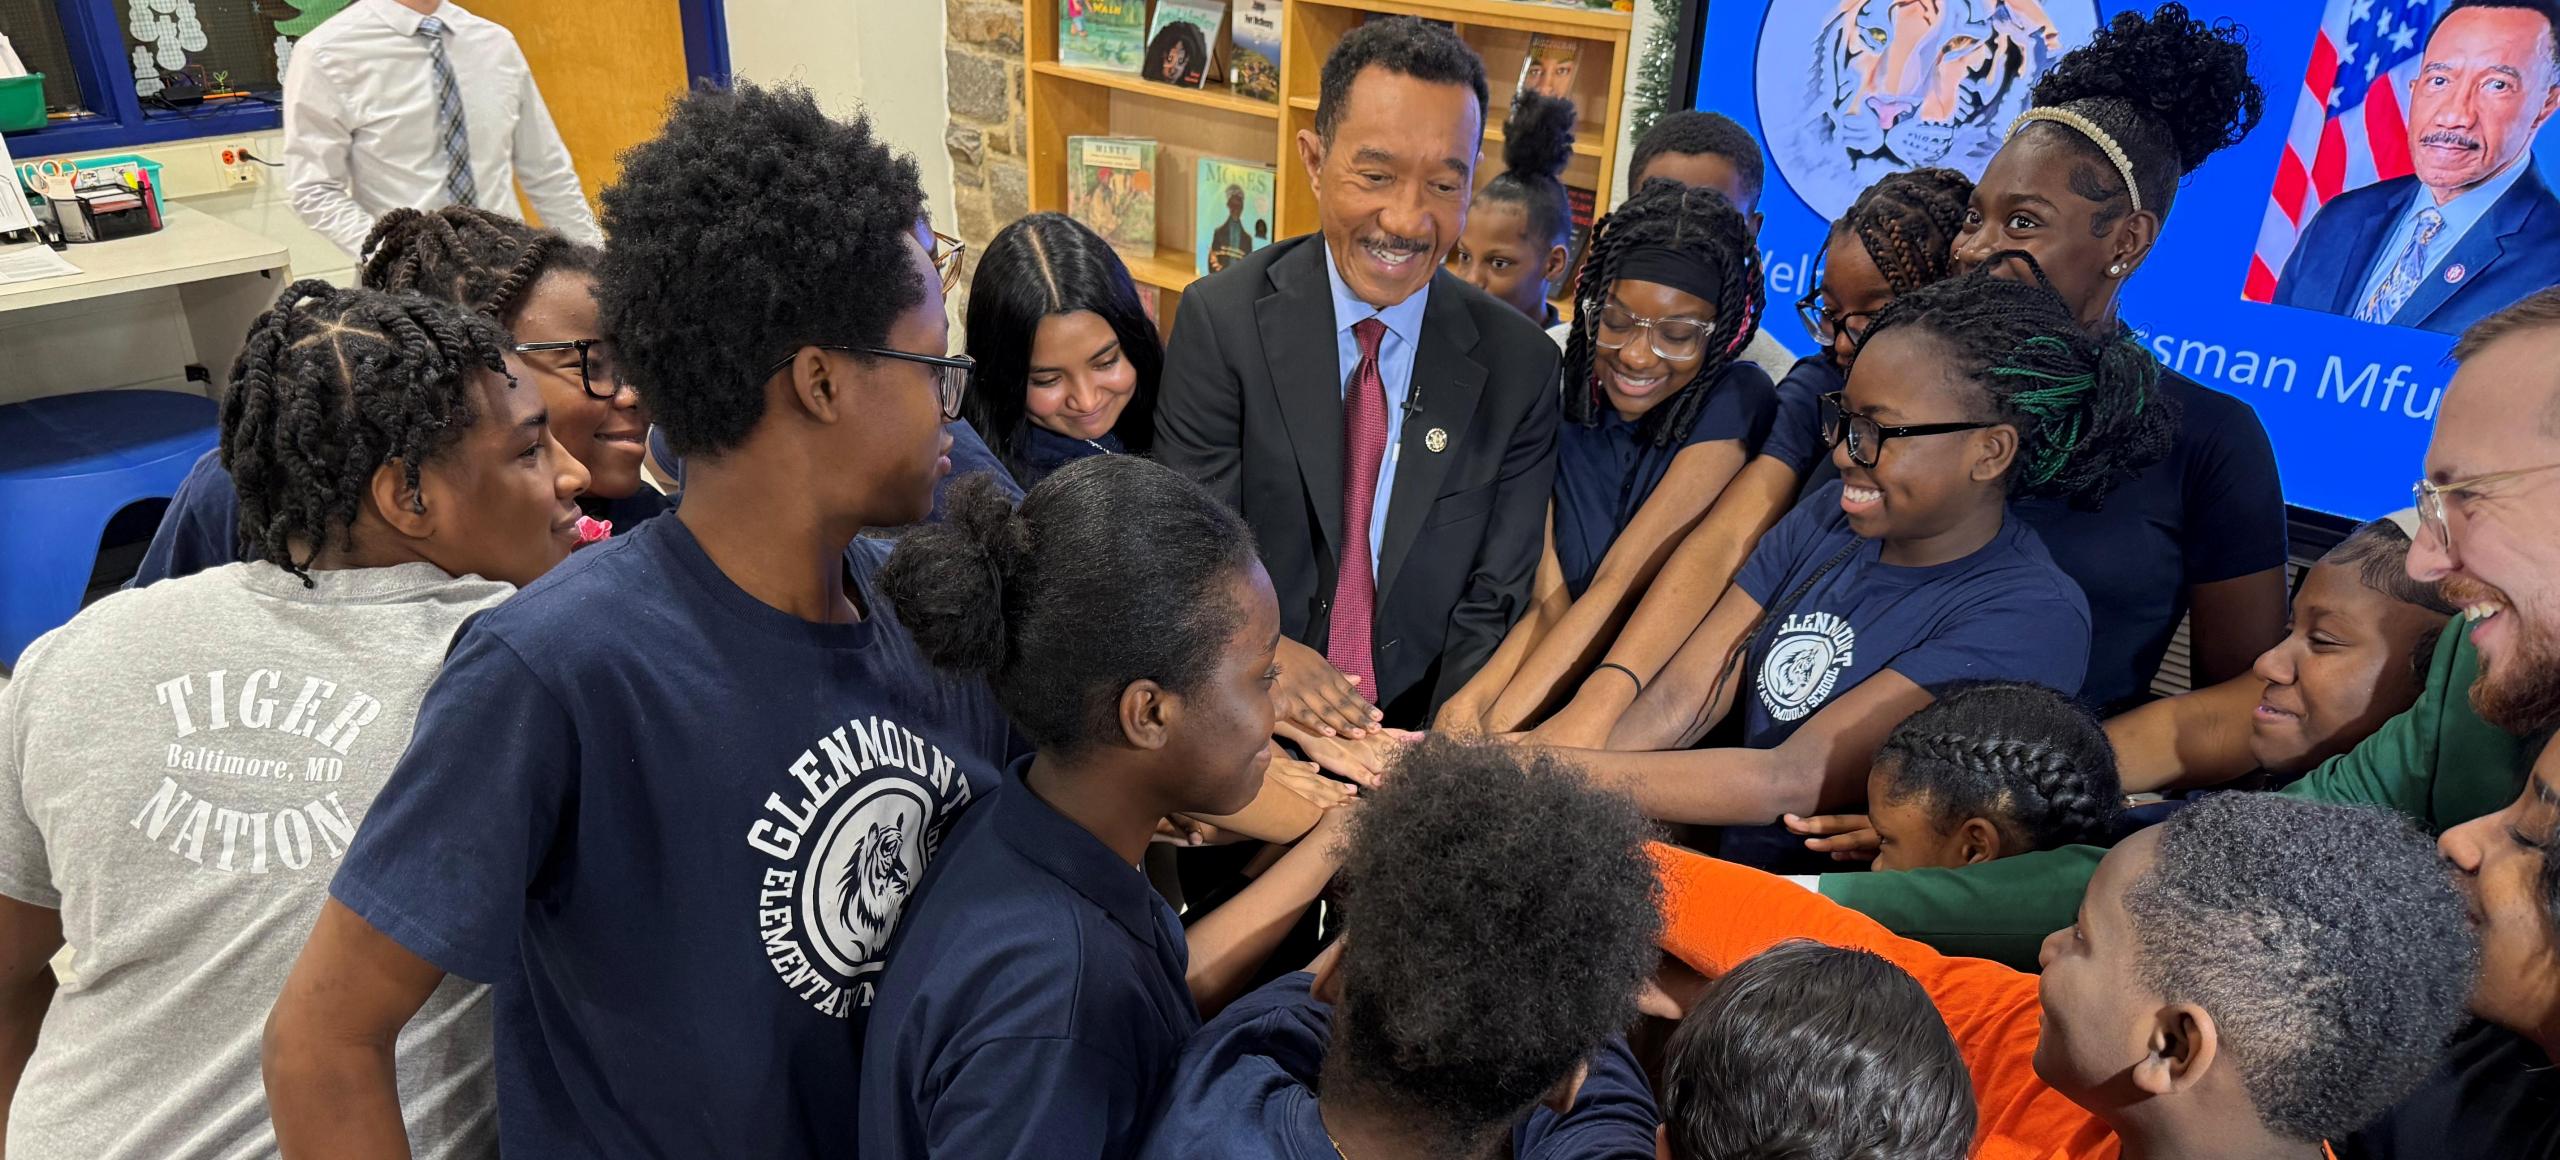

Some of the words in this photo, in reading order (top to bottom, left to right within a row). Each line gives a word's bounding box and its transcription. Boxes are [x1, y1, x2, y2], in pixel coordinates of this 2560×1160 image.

[155, 668, 382, 757] TIGER
[1807, 667, 1841, 708] SCHOOL
[166, 743, 295, 783] Baltimore,
[304, 756, 344, 783] MD
[746, 715, 973, 861] GLENMOUNT
[129, 775, 358, 875] NATION
